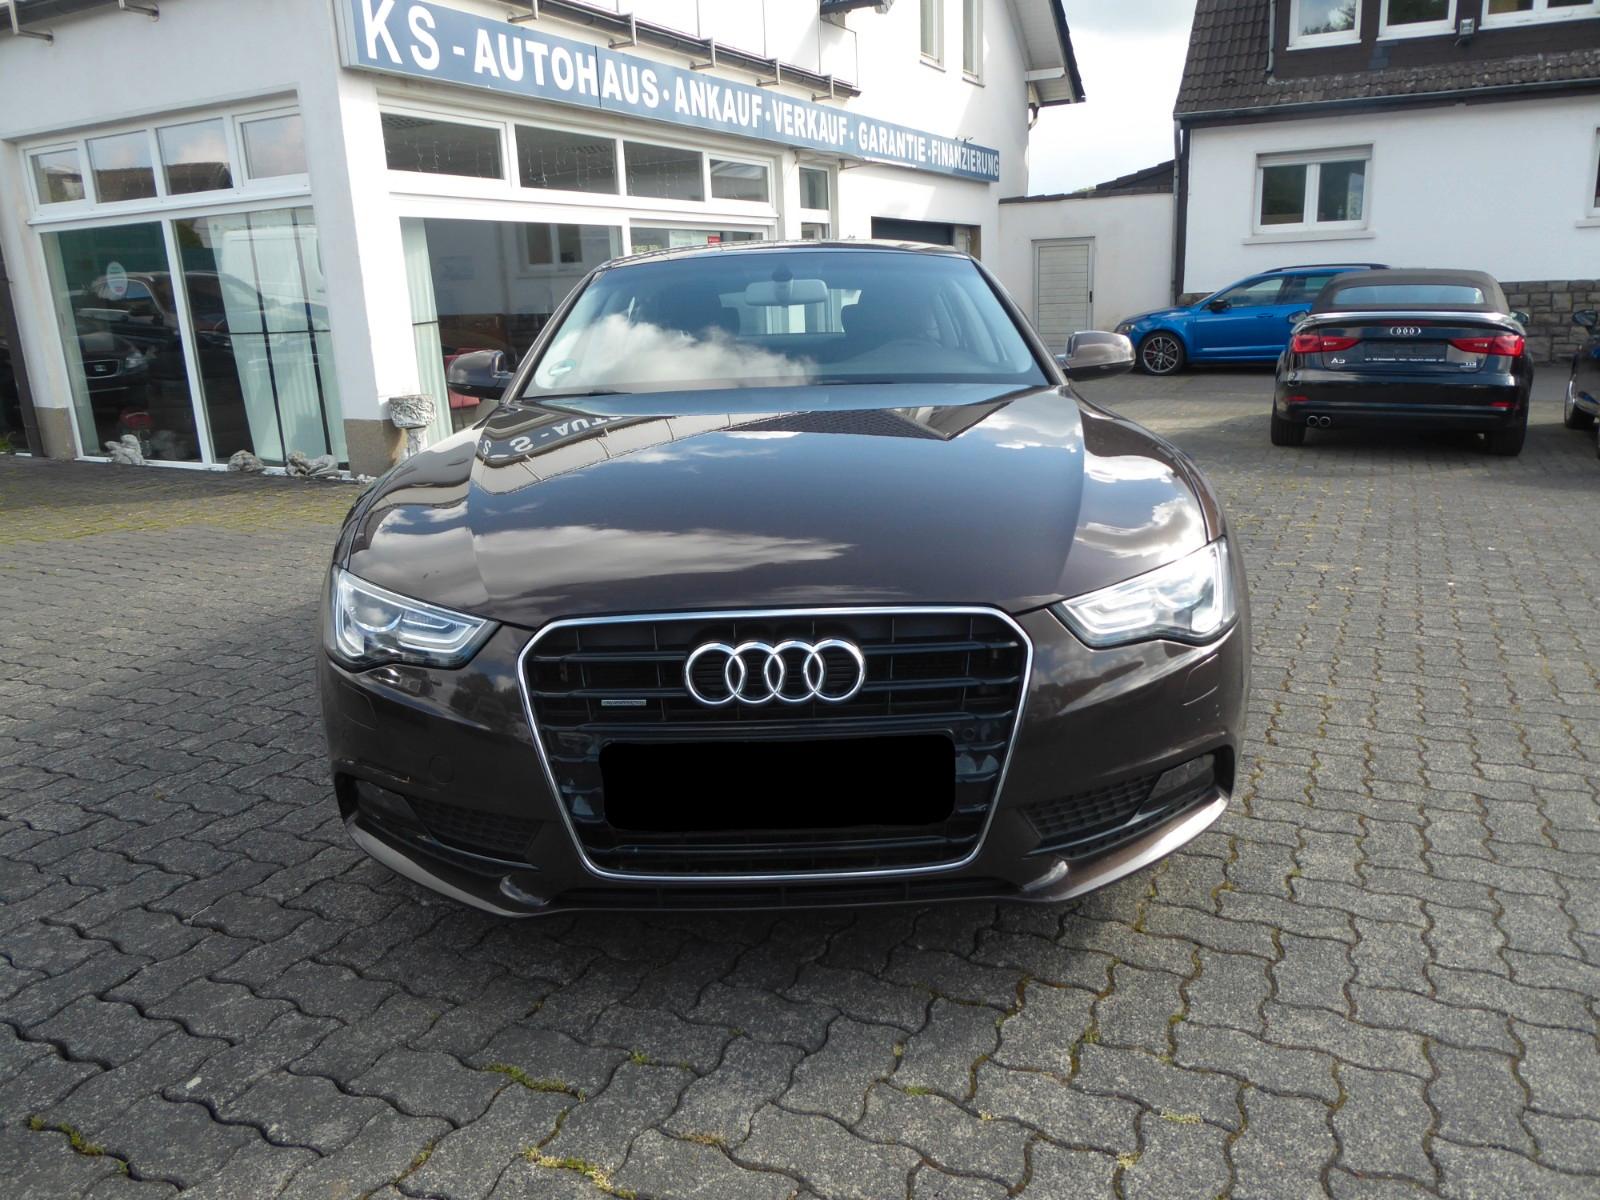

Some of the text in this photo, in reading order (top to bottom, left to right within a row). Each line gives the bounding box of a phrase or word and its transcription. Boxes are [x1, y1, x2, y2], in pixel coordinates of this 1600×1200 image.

[361, 0, 440, 71] KS
[474, 28, 660, 109] AUTOHAUS
[674, 76, 762, 128] ANKAUF
[772, 98, 847, 145] VERKAUF
[858, 121, 926, 162] GARANTIE
[931, 140, 999, 177] FINANZIERUNG
